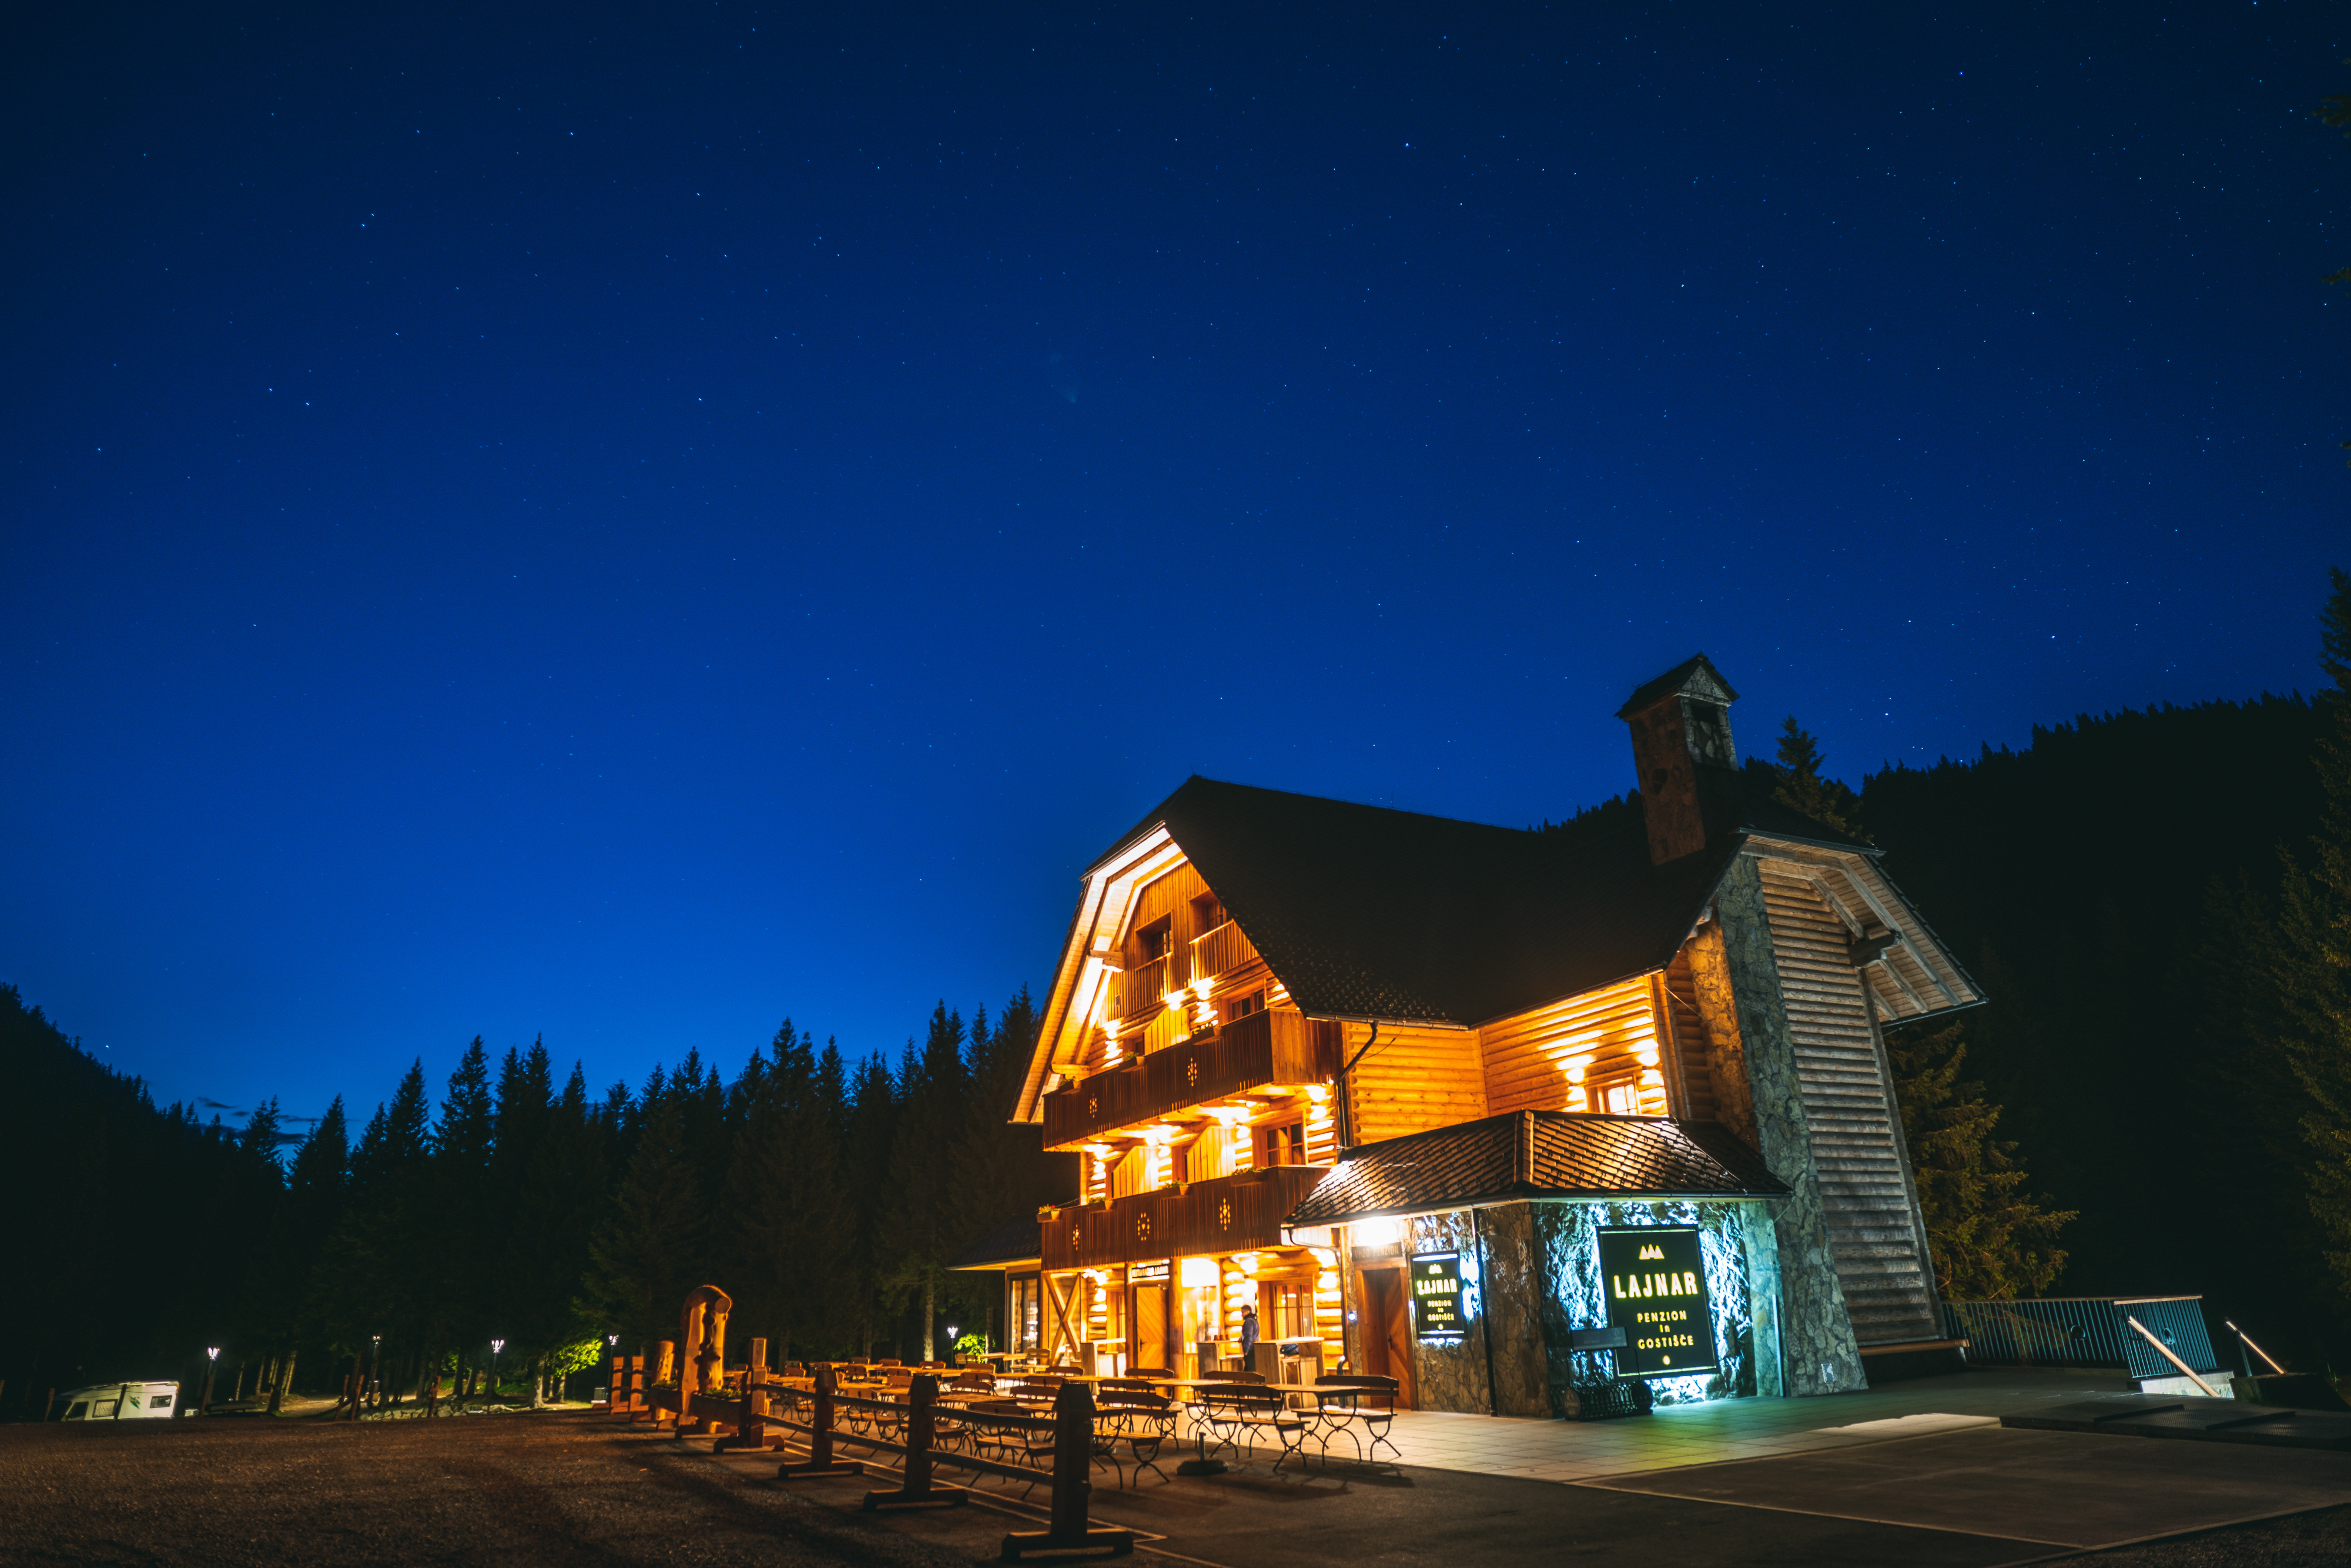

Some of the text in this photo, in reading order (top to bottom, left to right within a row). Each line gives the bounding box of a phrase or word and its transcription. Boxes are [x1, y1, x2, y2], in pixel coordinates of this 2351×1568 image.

[1355, 1245, 1399, 1258] VHOD PENZION
[1416, 1278, 1458, 1295] LAJNAR
[1614, 1272, 1698, 1298] LAJNAR
[1637, 1310, 1687, 1323] PENZION
[1637, 1334, 1694, 1349] GOSTIŠČE
